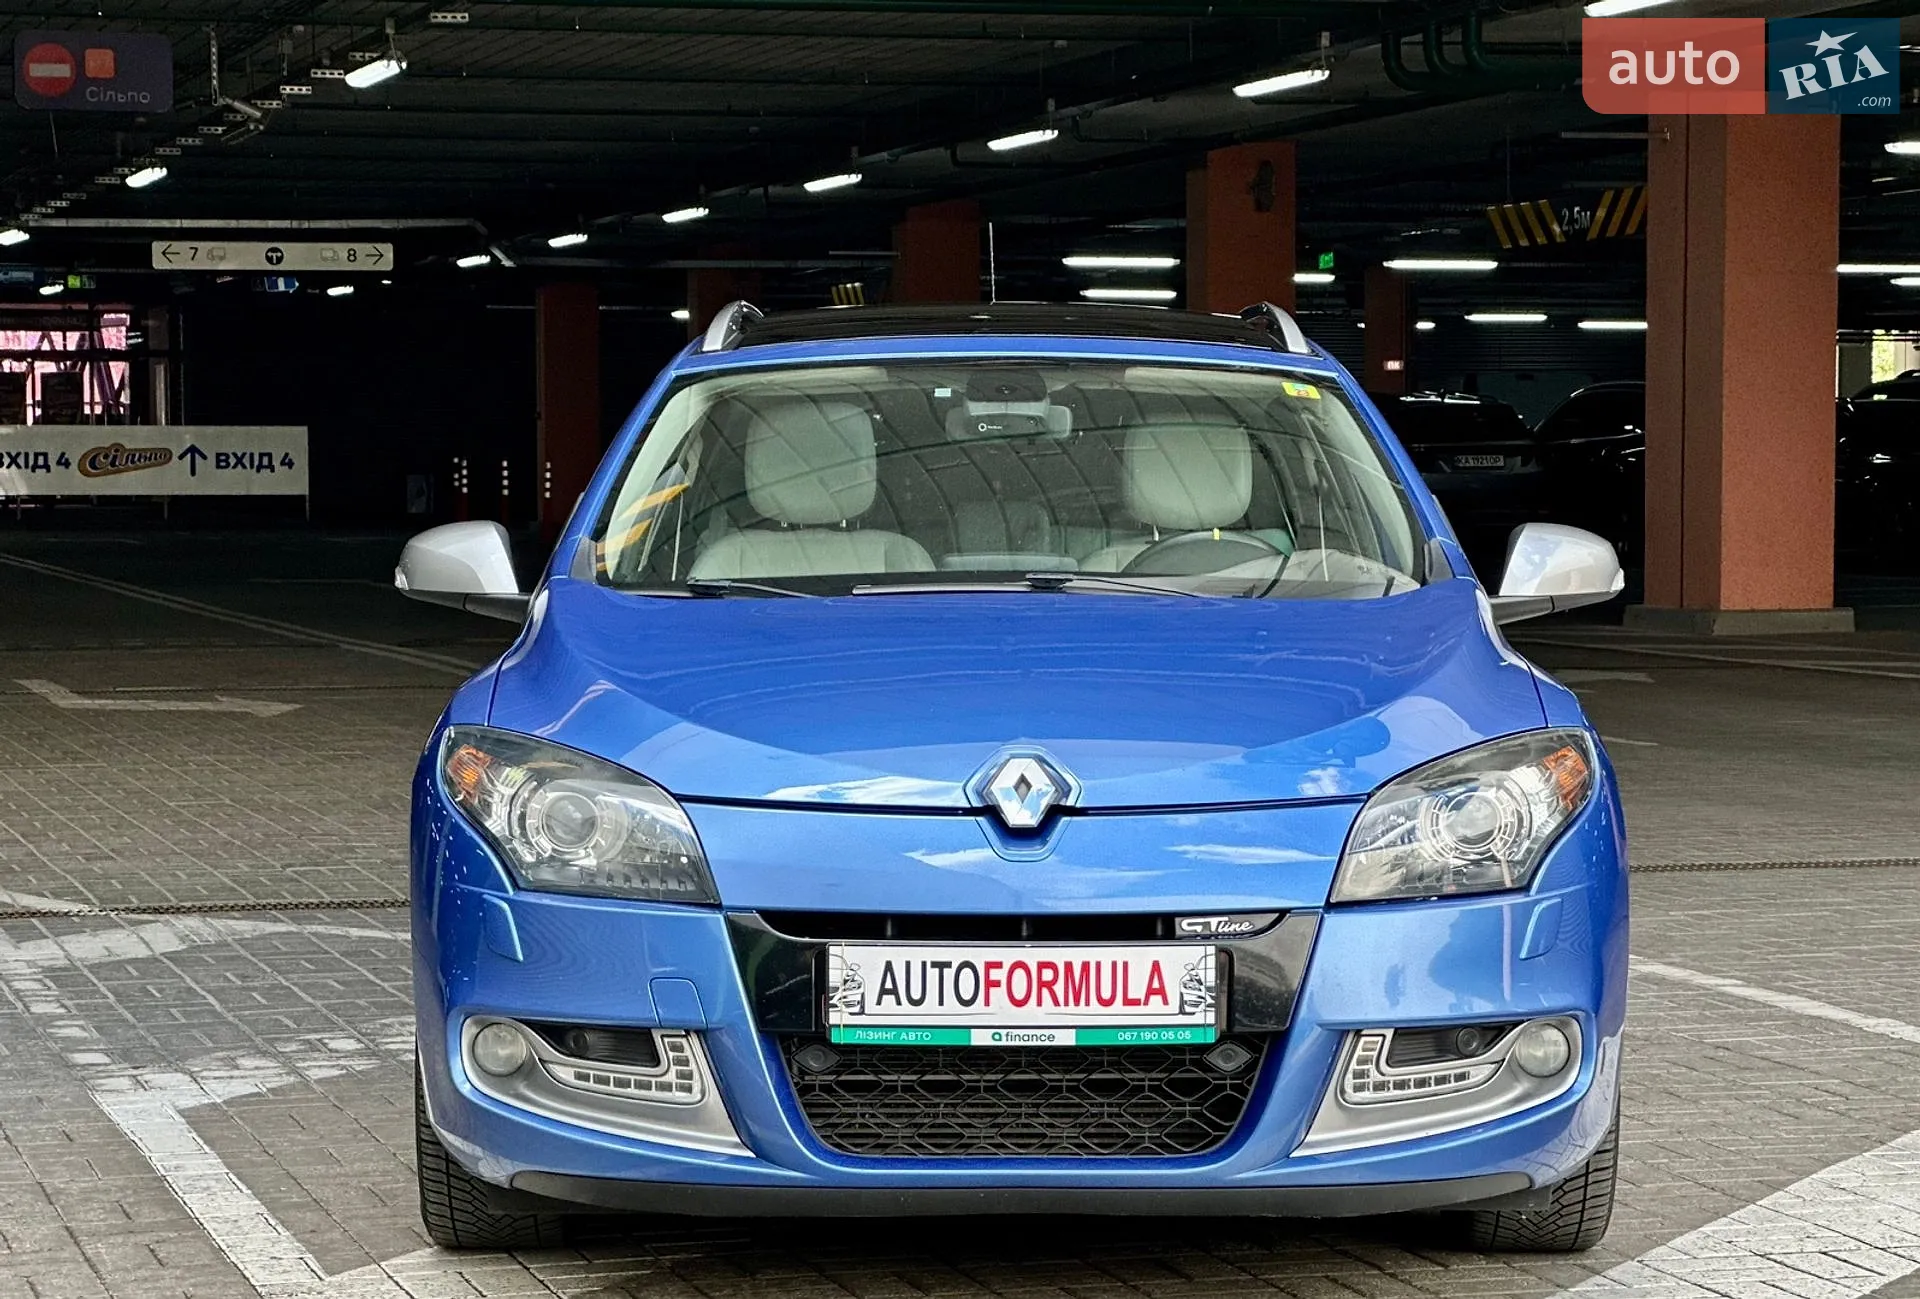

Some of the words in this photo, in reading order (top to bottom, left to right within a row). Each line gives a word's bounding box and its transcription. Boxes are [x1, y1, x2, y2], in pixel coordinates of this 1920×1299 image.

[86, 86, 151, 104] Сільпо
[189, 246, 199, 261] 7
[346, 247, 358, 262] 8
[56, 451, 71, 470] 4
[215, 452, 275, 473] ВХІД
[279, 452, 295, 470] 4
[875, 960, 1170, 1007] AUTOFORMULA
[855, 1030, 897, 1040] ЛІЗИНГ
[899, 1032, 932, 1041] АВТО
[1005, 1031, 1056, 1042] finance
[1117, 1032, 1138, 1041] 067
[1140, 1031, 1158, 1041] 190
[1160, 1031, 1175, 1040] 05
[1176, 1030, 1192, 1040] 05
